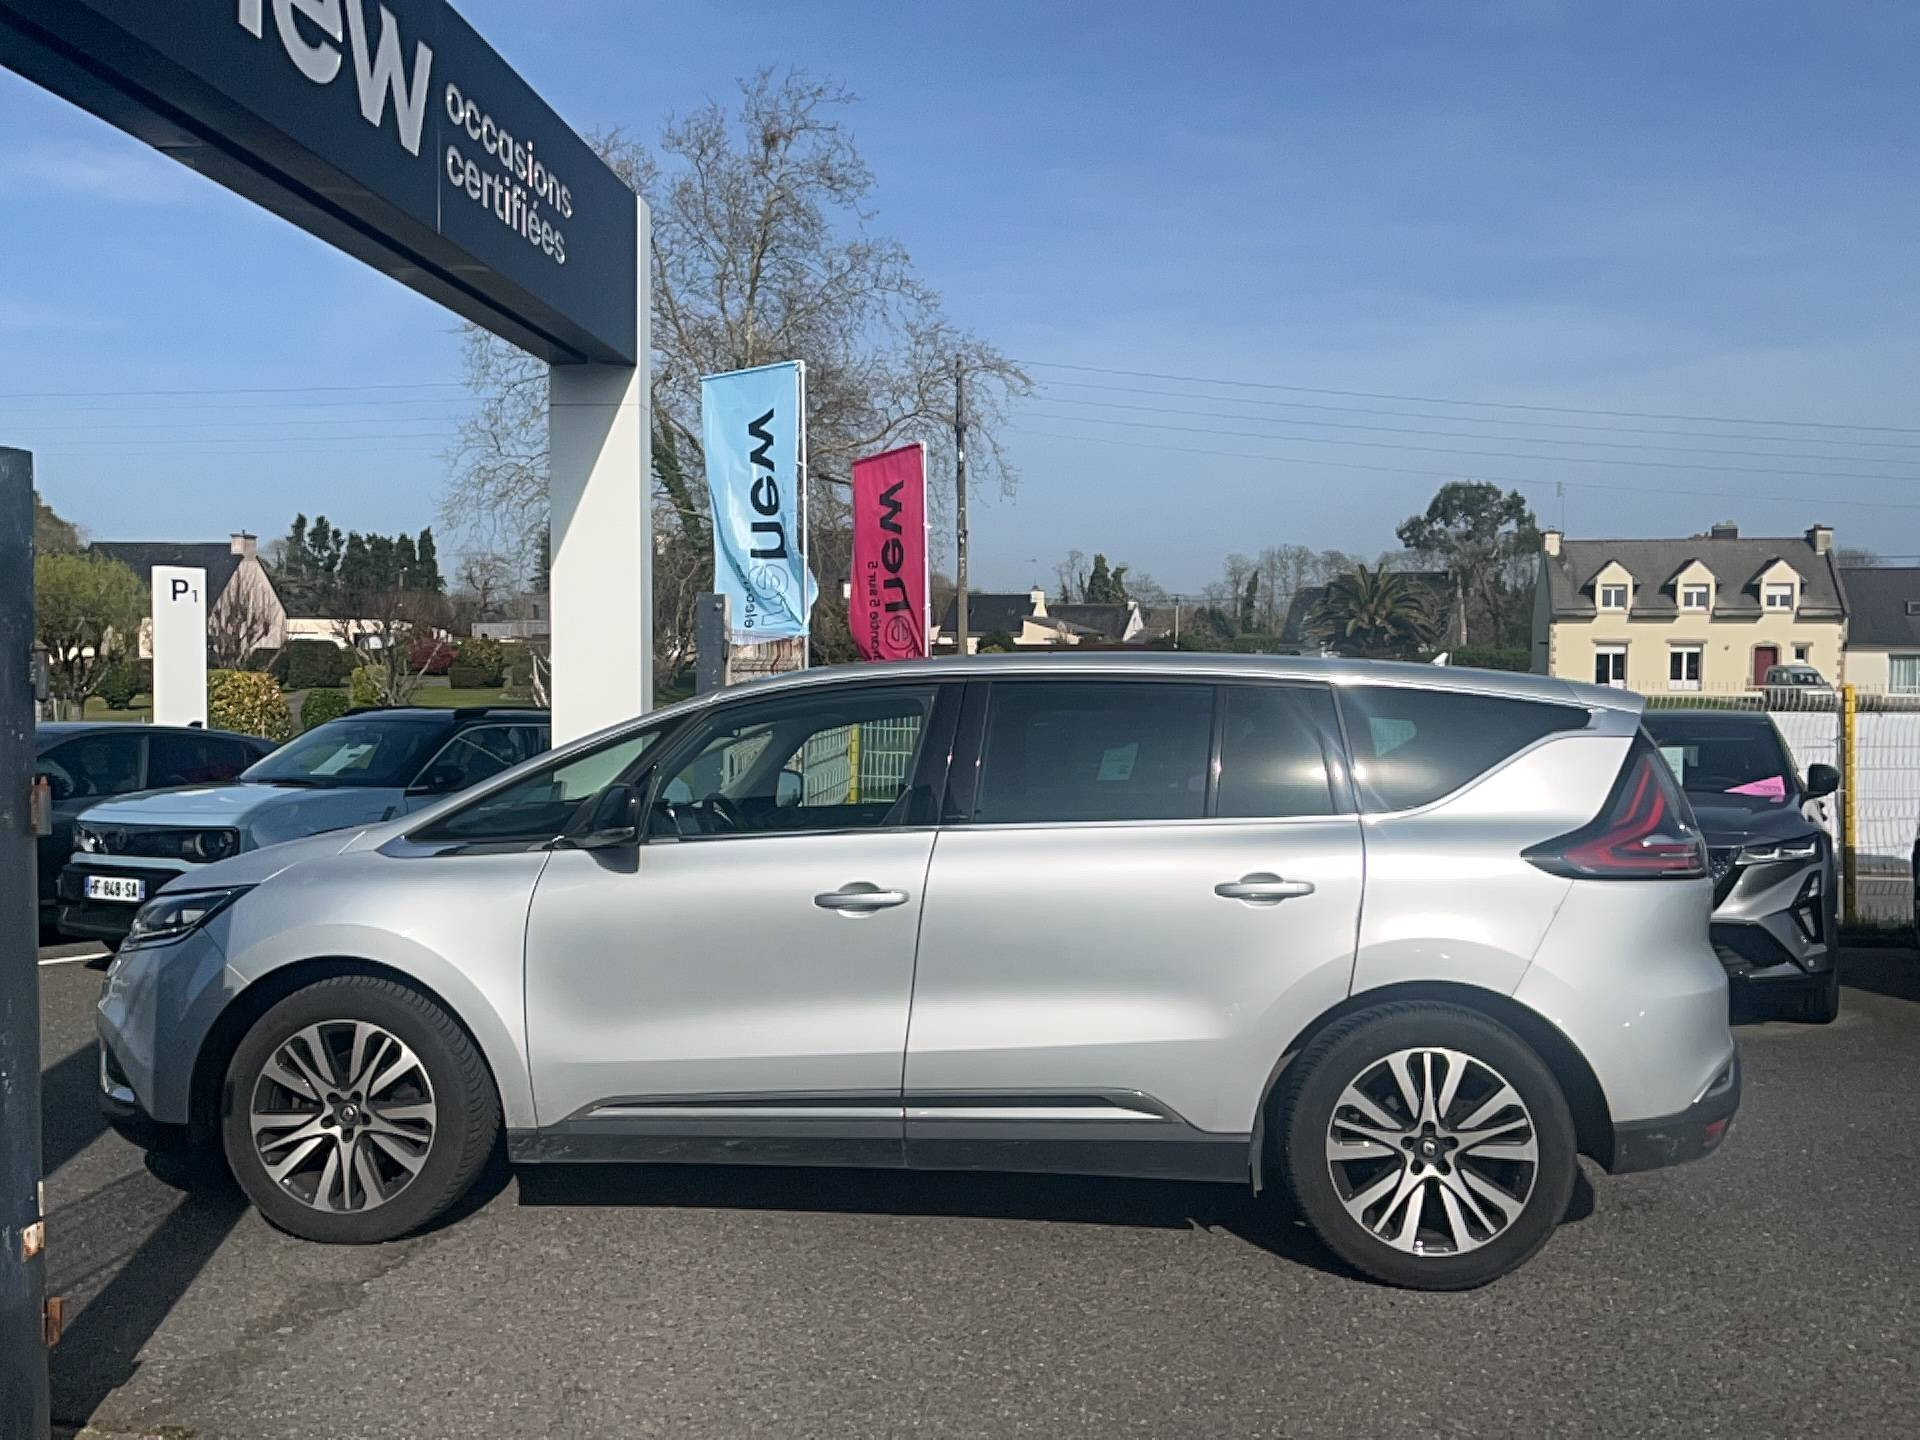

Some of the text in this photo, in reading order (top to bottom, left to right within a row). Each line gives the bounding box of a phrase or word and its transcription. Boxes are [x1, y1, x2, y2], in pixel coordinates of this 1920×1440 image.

[238, 0, 433, 158] ew
[445, 82, 574, 219] occasions
[445, 145, 567, 265] certifiées
